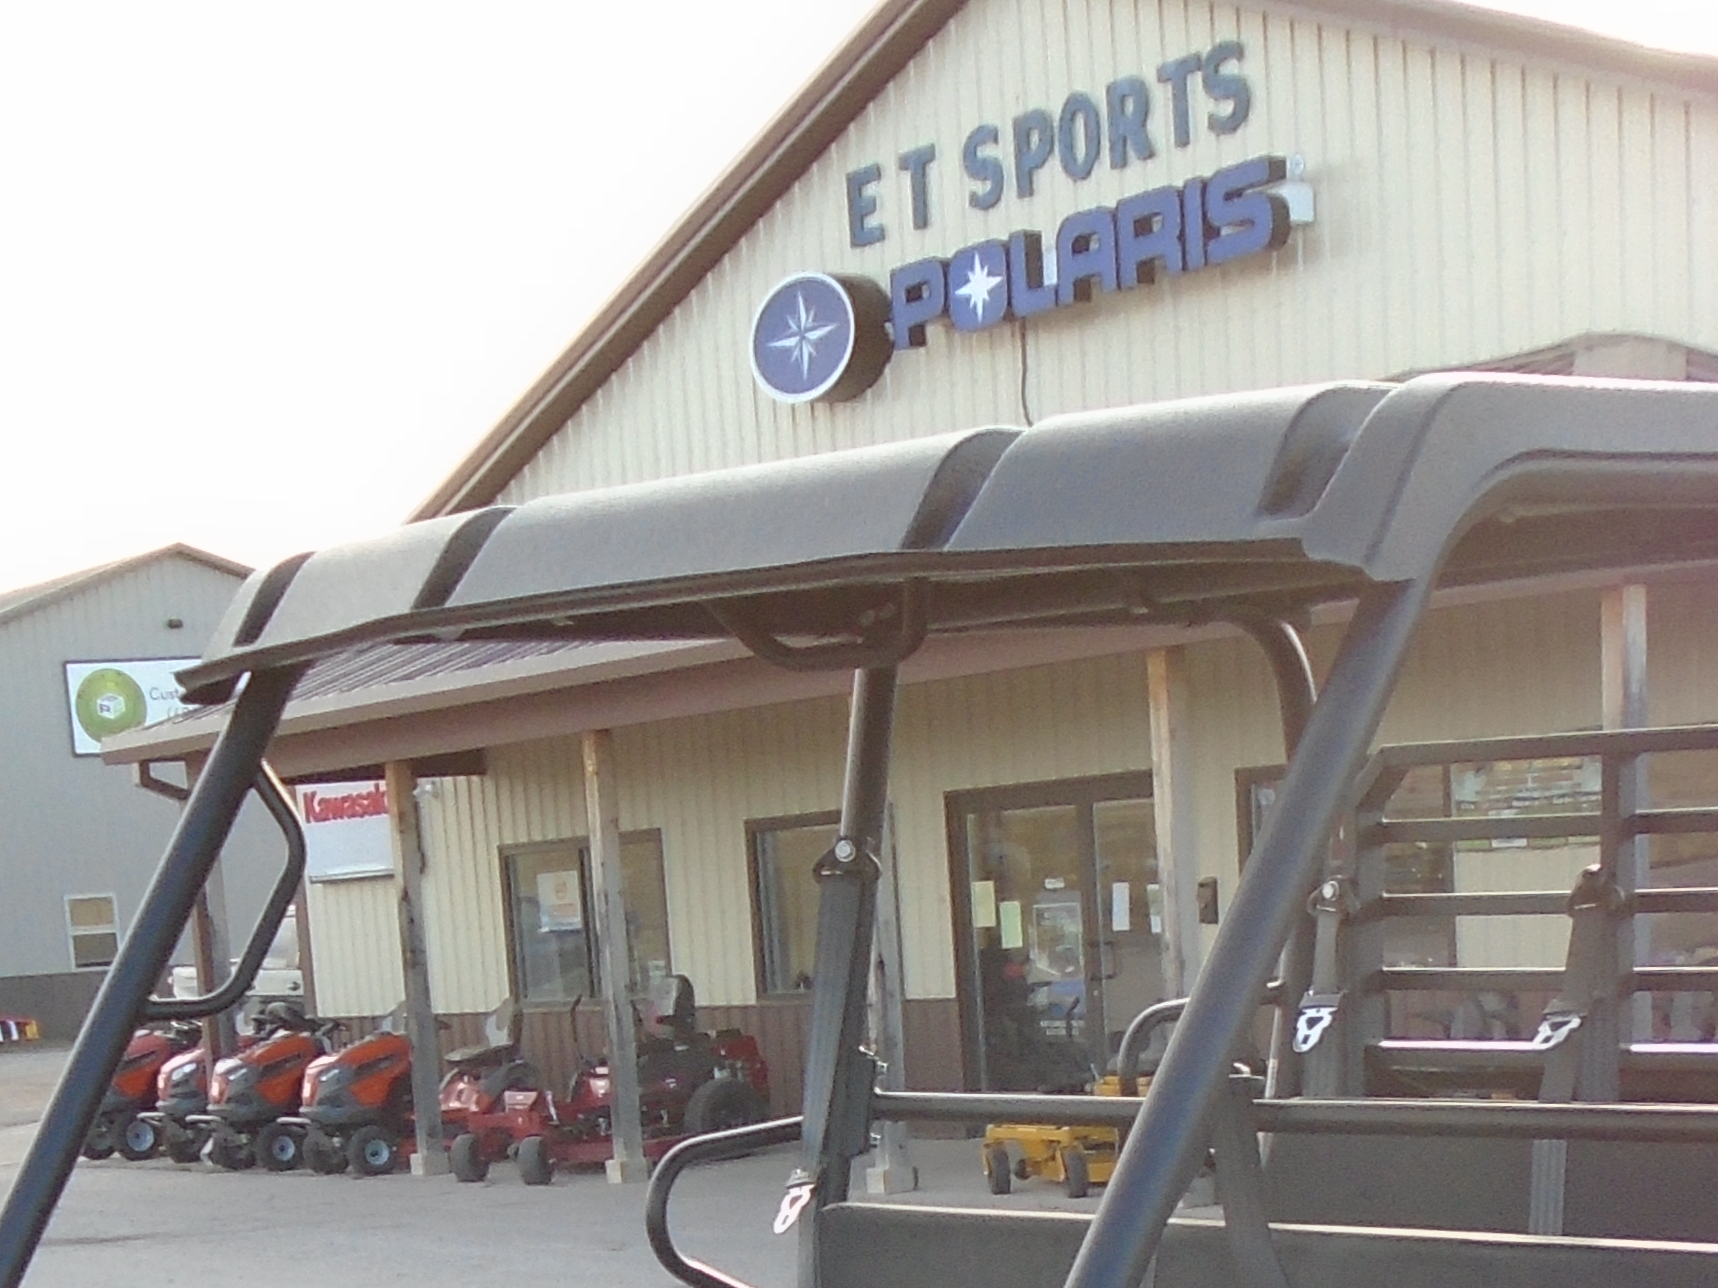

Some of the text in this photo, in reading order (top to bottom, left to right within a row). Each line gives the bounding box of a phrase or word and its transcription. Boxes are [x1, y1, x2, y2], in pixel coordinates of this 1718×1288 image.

[845, 40, 1252, 248] E T SPORTS
[887, 155, 1287, 350] POLARIS
[302, 782, 389, 824] Kawasak
